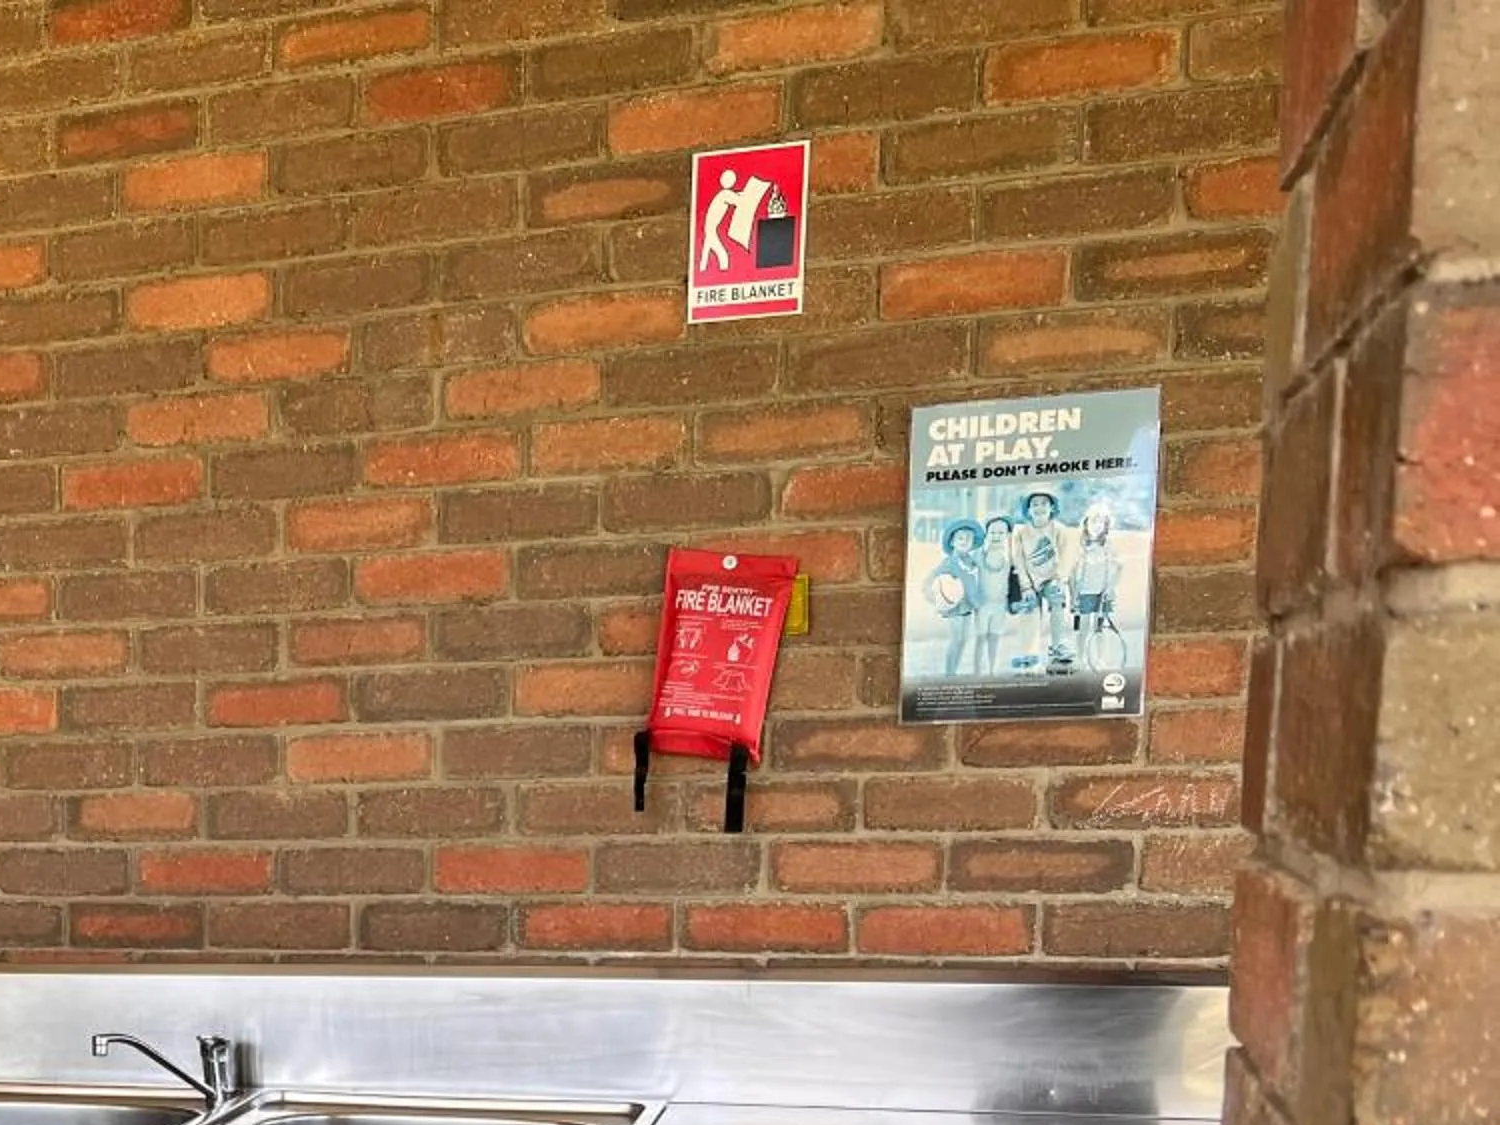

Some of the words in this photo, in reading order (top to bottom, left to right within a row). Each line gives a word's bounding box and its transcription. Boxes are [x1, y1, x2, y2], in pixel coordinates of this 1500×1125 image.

[697, 288, 727, 304] FIRE
[731, 281, 795, 301] BLANKET
[928, 407, 1082, 441] CHILDREN
[926, 443, 965, 467] AT
[975, 435, 1060, 465] PLAY.
[925, 467, 977, 482] PLEASE
[982, 465, 1031, 479] DON'T
[1035, 459, 1090, 474] SMOKE
[1095, 457, 1138, 470] HERE.
[675, 589, 706, 611] FIRE
[707, 592, 773, 618] BLANKET
